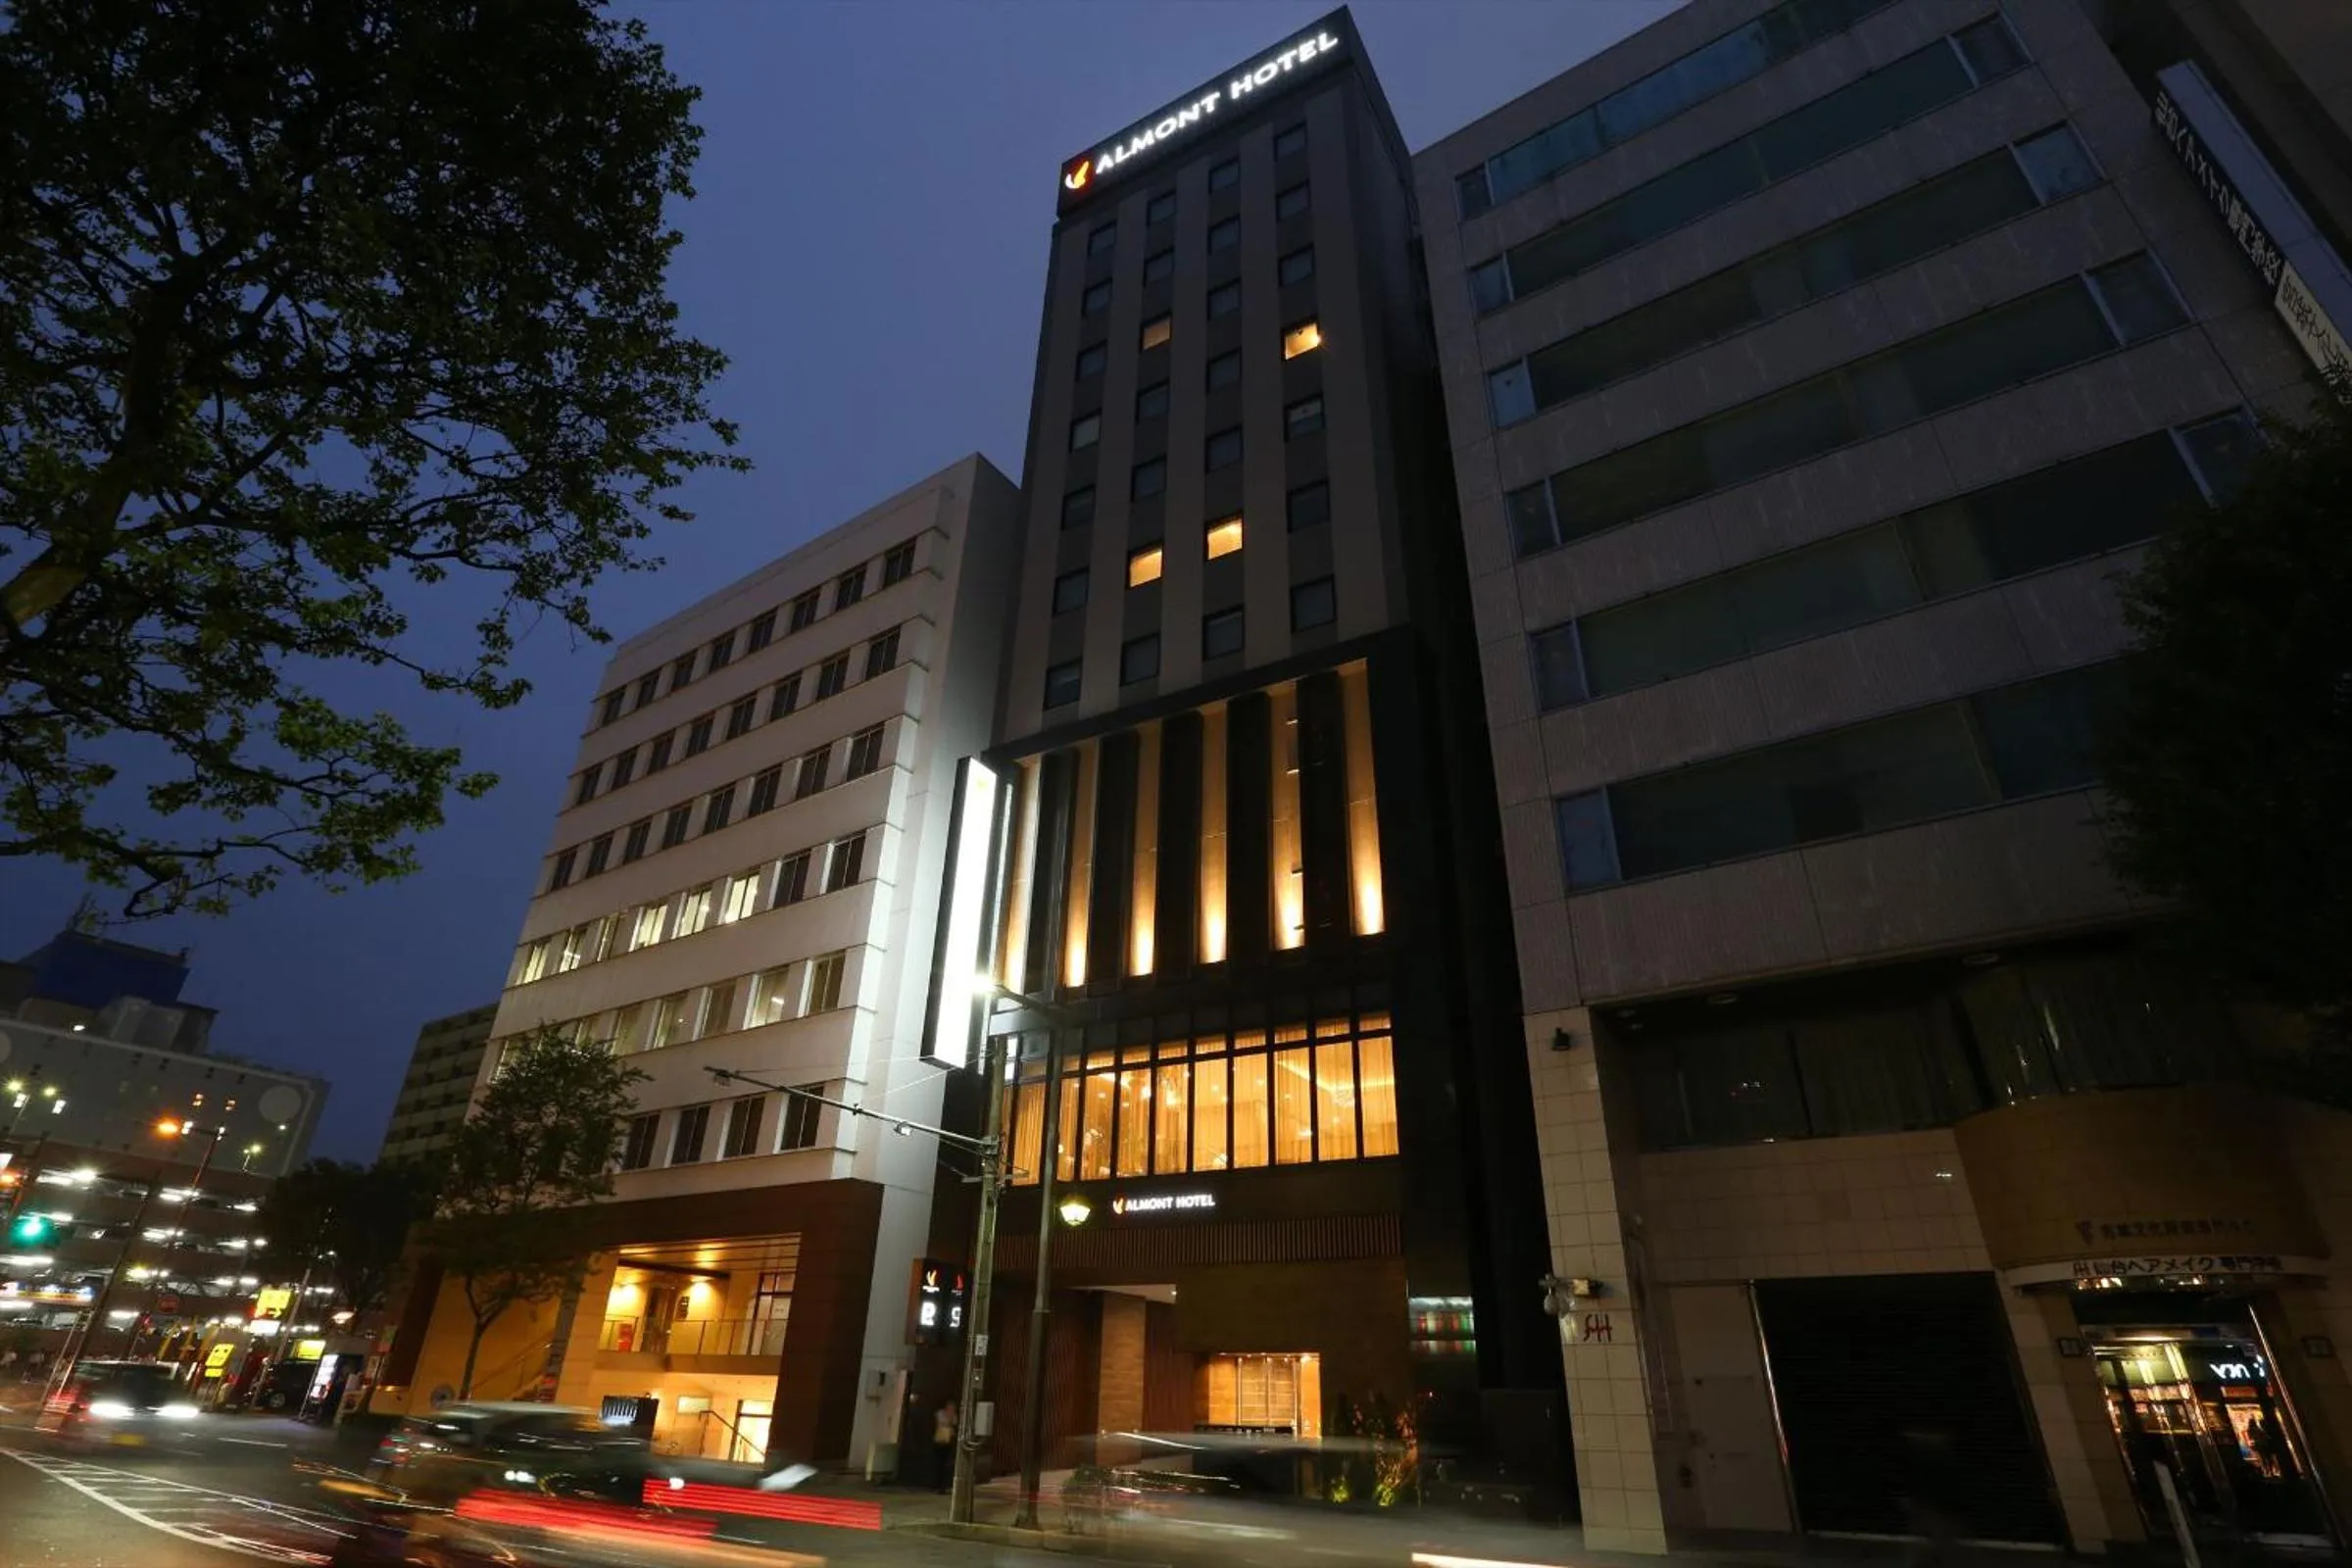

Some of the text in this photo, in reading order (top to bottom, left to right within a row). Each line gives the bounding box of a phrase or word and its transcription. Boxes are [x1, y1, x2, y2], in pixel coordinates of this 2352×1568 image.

[1095, 31, 1339, 174] ALMONT HOTEL
[1125, 1194, 1216, 1211] ALMONT HOTEL
